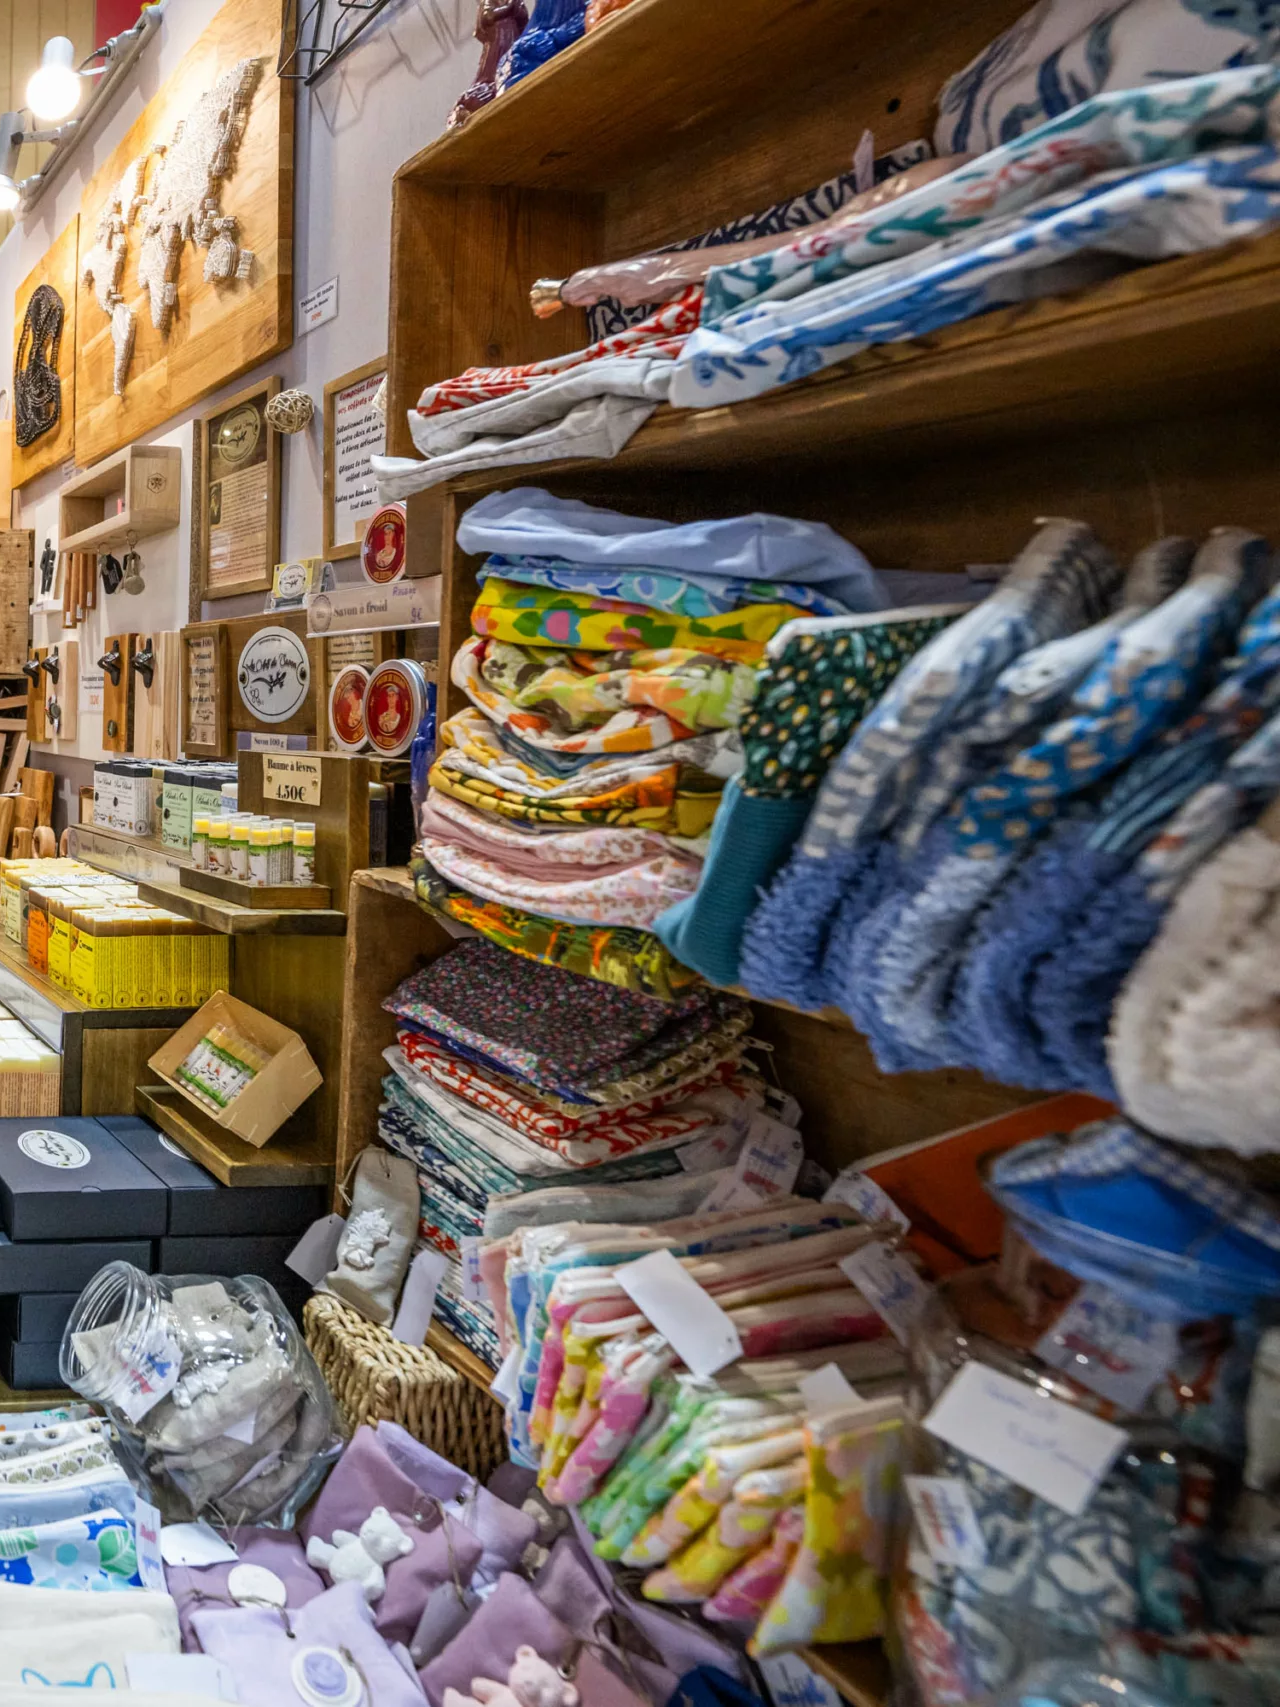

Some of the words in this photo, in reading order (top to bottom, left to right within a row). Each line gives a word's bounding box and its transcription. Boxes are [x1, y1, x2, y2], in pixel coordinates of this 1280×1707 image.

[333, 607, 358, 617] Savon
[359, 604, 365, 614] à
[366, 599, 388, 614] froid
[254, 738, 269, 746] Savon
[270, 738, 280, 746] 100
[267, 758, 289, 771] Baume
[290, 761, 295, 771] à
[296, 761, 317, 773] lèvres
